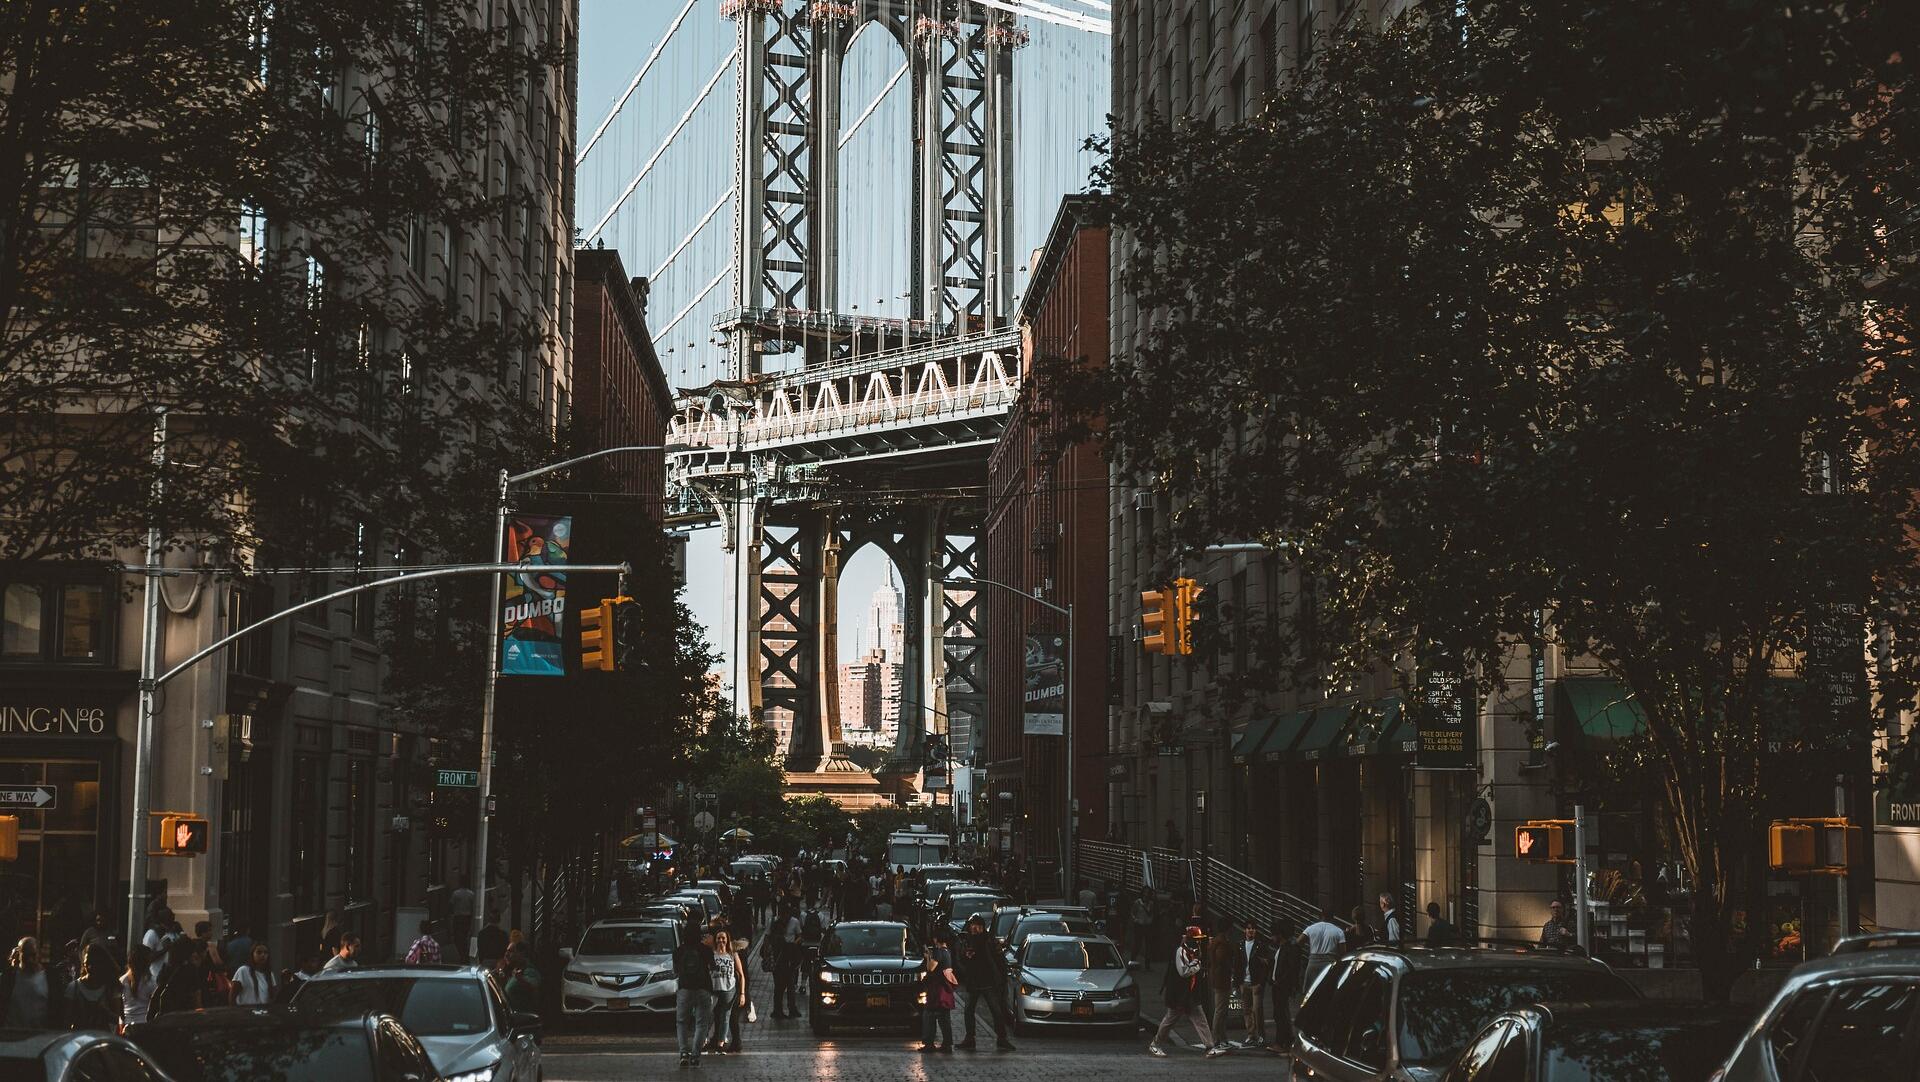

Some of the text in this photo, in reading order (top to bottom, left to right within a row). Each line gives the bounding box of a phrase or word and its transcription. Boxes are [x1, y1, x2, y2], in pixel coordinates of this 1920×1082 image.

[505, 597, 565, 624] DUMBO
[1025, 684, 1064, 702] DUMBO
[439, 773, 466, 784] FRONT
[16, 792, 35, 801] WAY
[1891, 804, 1920, 821] FRONT
